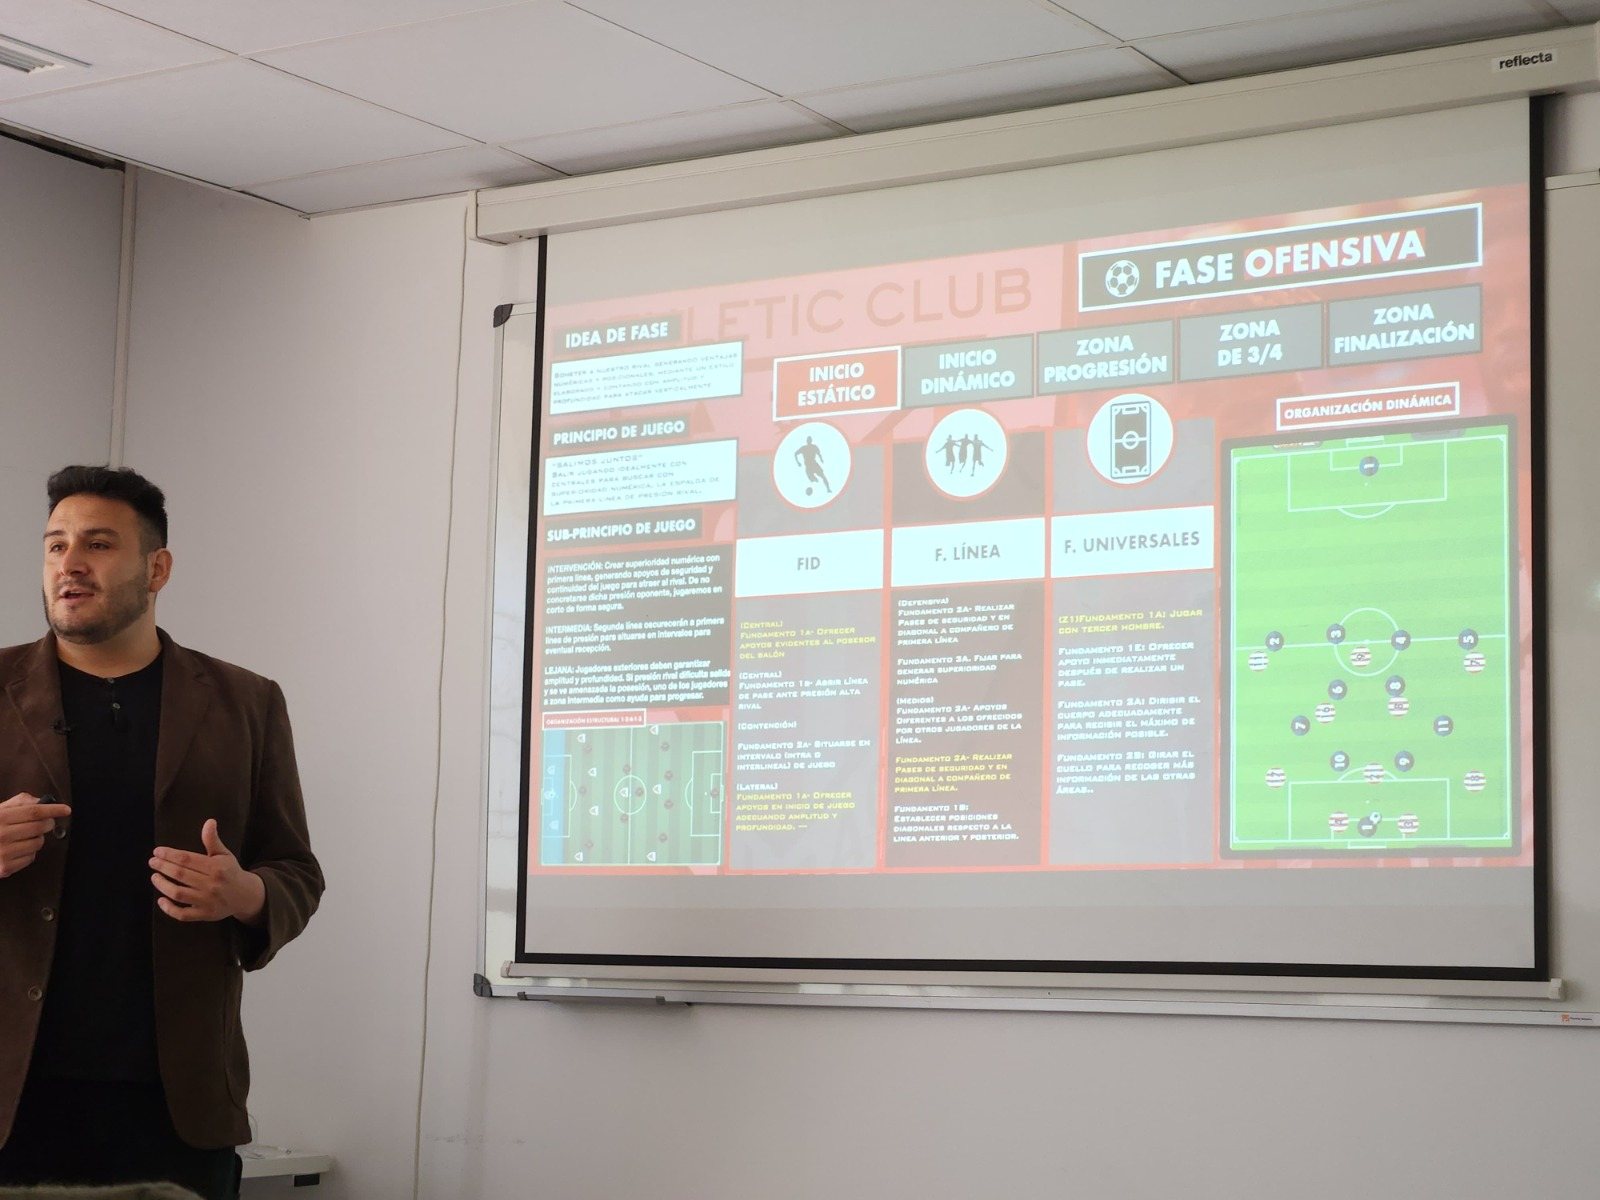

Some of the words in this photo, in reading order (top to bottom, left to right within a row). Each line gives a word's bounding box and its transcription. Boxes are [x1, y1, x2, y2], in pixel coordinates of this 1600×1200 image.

[1500, 52, 1552, 69] reflecta
[1156, 253, 1233, 288] FASE
[1246, 230, 1425, 278] OFENSIVA
[867, 268, 1031, 327] CLUB
[1374, 303, 1434, 326] ZONA
[566, 330, 601, 349] IDEA
[606, 327, 626, 344] DE
[631, 322, 668, 340] FASE
[1219, 319, 1280, 342] ZONA
[1335, 321, 1475, 354] FINALIZACIÓN
[1076, 335, 1133, 356] ZONA
[1218, 348, 1243, 366] DE
[1247, 344, 1283, 364] 3/4
[939, 349, 997, 370] INICIO
[1044, 353, 1167, 383] PROGRESIÓN
[809, 362, 864, 383] INICIO
[922, 370, 1015, 395] DINÁMICO
[797, 384, 876, 407] ESTÁTICO
[1285, 399, 1382, 419] ORGANIZACIÓN
[1385, 393, 1452, 410] DINÁMICA
[554, 428, 617, 445] PRINCIPIO
[622, 425, 637, 438] DE
[640, 420, 685, 436] JUEGO
[547, 524, 632, 542] SUB-PRINCIPIO
[636, 523, 650, 534] DE
[654, 519, 696, 533] JUEGO
[935, 548, 947, 562] F.
[953, 543, 1001, 561] LÍNEA
[1064, 539, 1076, 554] F.
[1083, 531, 1200, 553] UNIVERSALES
[706, 554, 720, 563] con
[797, 557, 820, 571] FID
[546, 606, 564, 614] corto
[576, 604, 596, 612] forma
[1270, 637, 1279, 645] 2
[1396, 636, 1406, 644] 4
[1390, 682, 1401, 690] 8
[605, 694, 625, 702] como
[1438, 721, 1449, 731] 11
[1335, 754, 1345, 768] 10
